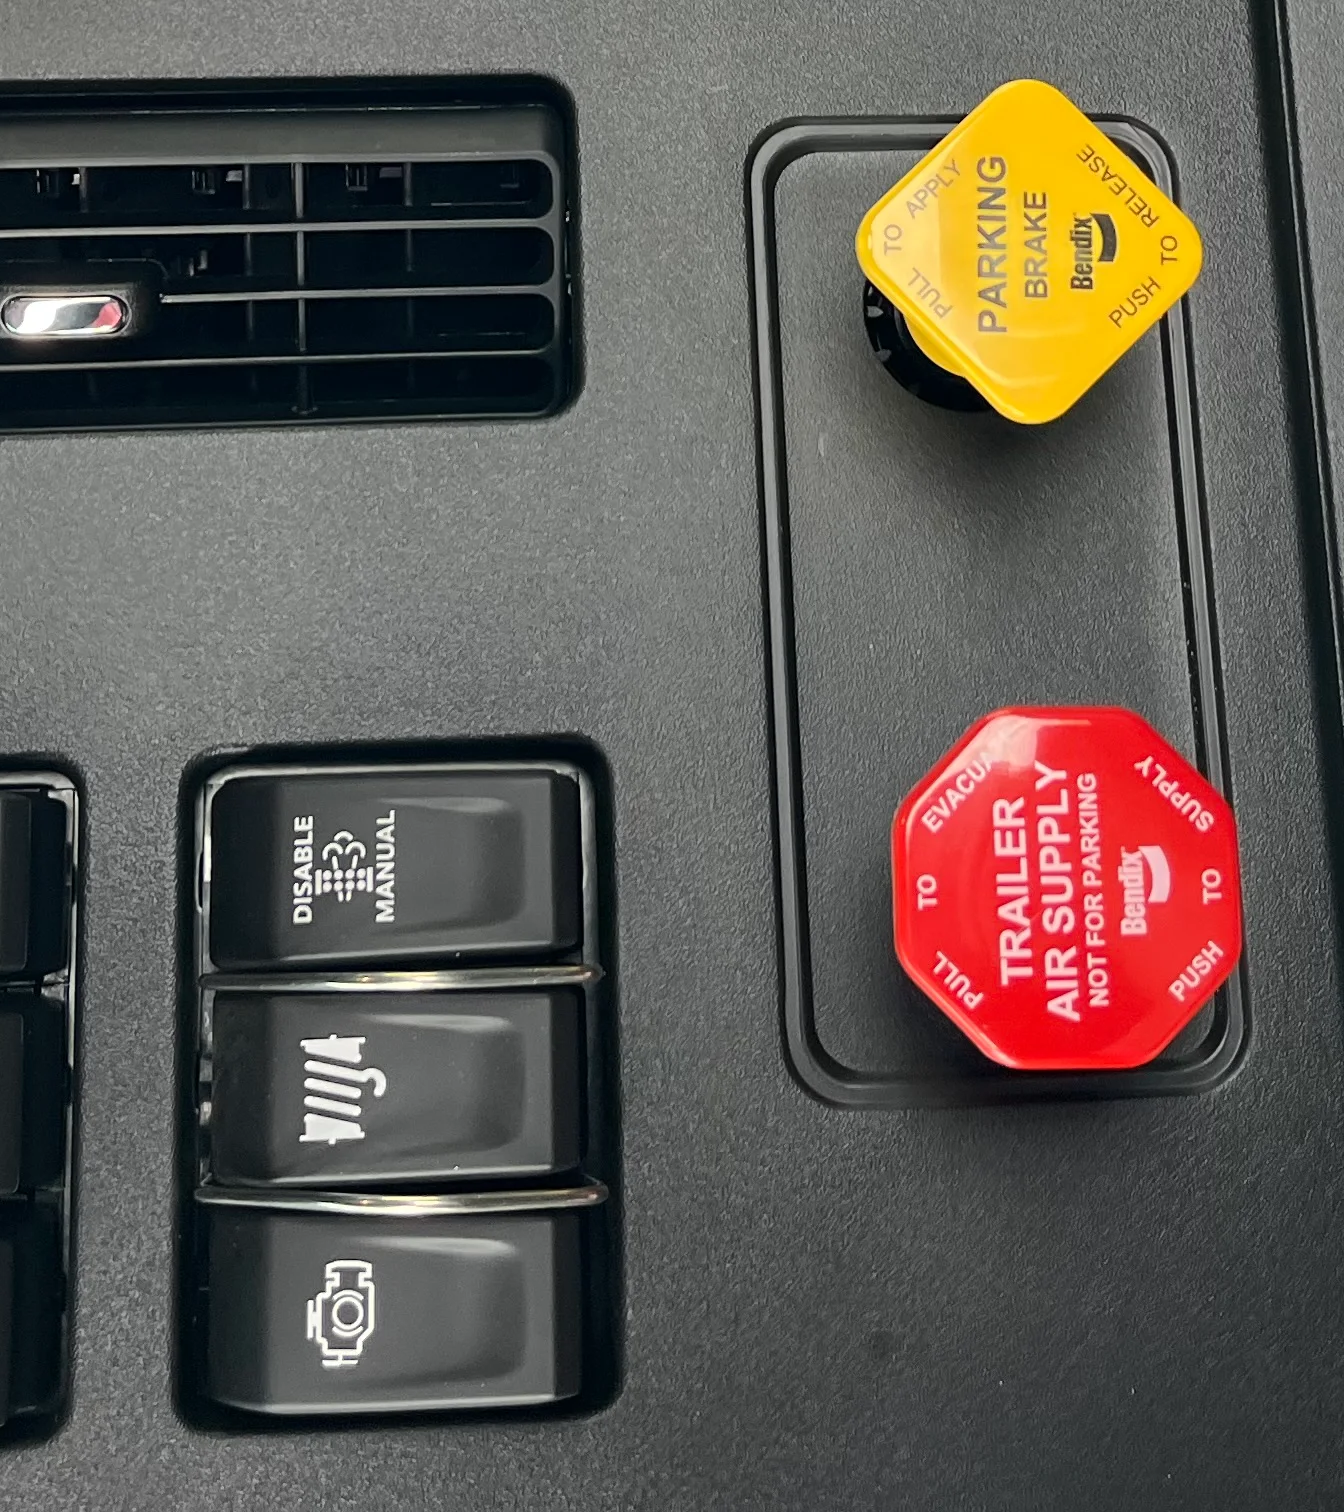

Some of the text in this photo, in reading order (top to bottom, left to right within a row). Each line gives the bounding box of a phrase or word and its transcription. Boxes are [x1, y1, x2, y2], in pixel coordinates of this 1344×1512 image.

[884, 157, 961, 320] PULL TO APPLY
[976, 154, 1008, 333] PARKING
[1022, 190, 1048, 299] BRAKE
[1070, 212, 1095, 291] Bendix
[1075, 143, 1179, 329] PUSH TO RELEASE
[292, 814, 315, 925] DISABLE
[374, 809, 396, 924] MANUAL
[916, 873, 939, 911] TO
[992, 796, 1034, 987] TRAILER
[1034, 759, 1082, 1023] AIR SUPPLY
[1076, 772, 1110, 1008] NOT FOR PARKING
[1118, 848, 1148, 936] Bendix
[1133, 754, 1225, 1002] PUSH TO SUPPLY
[932, 950, 985, 1011] PULL
